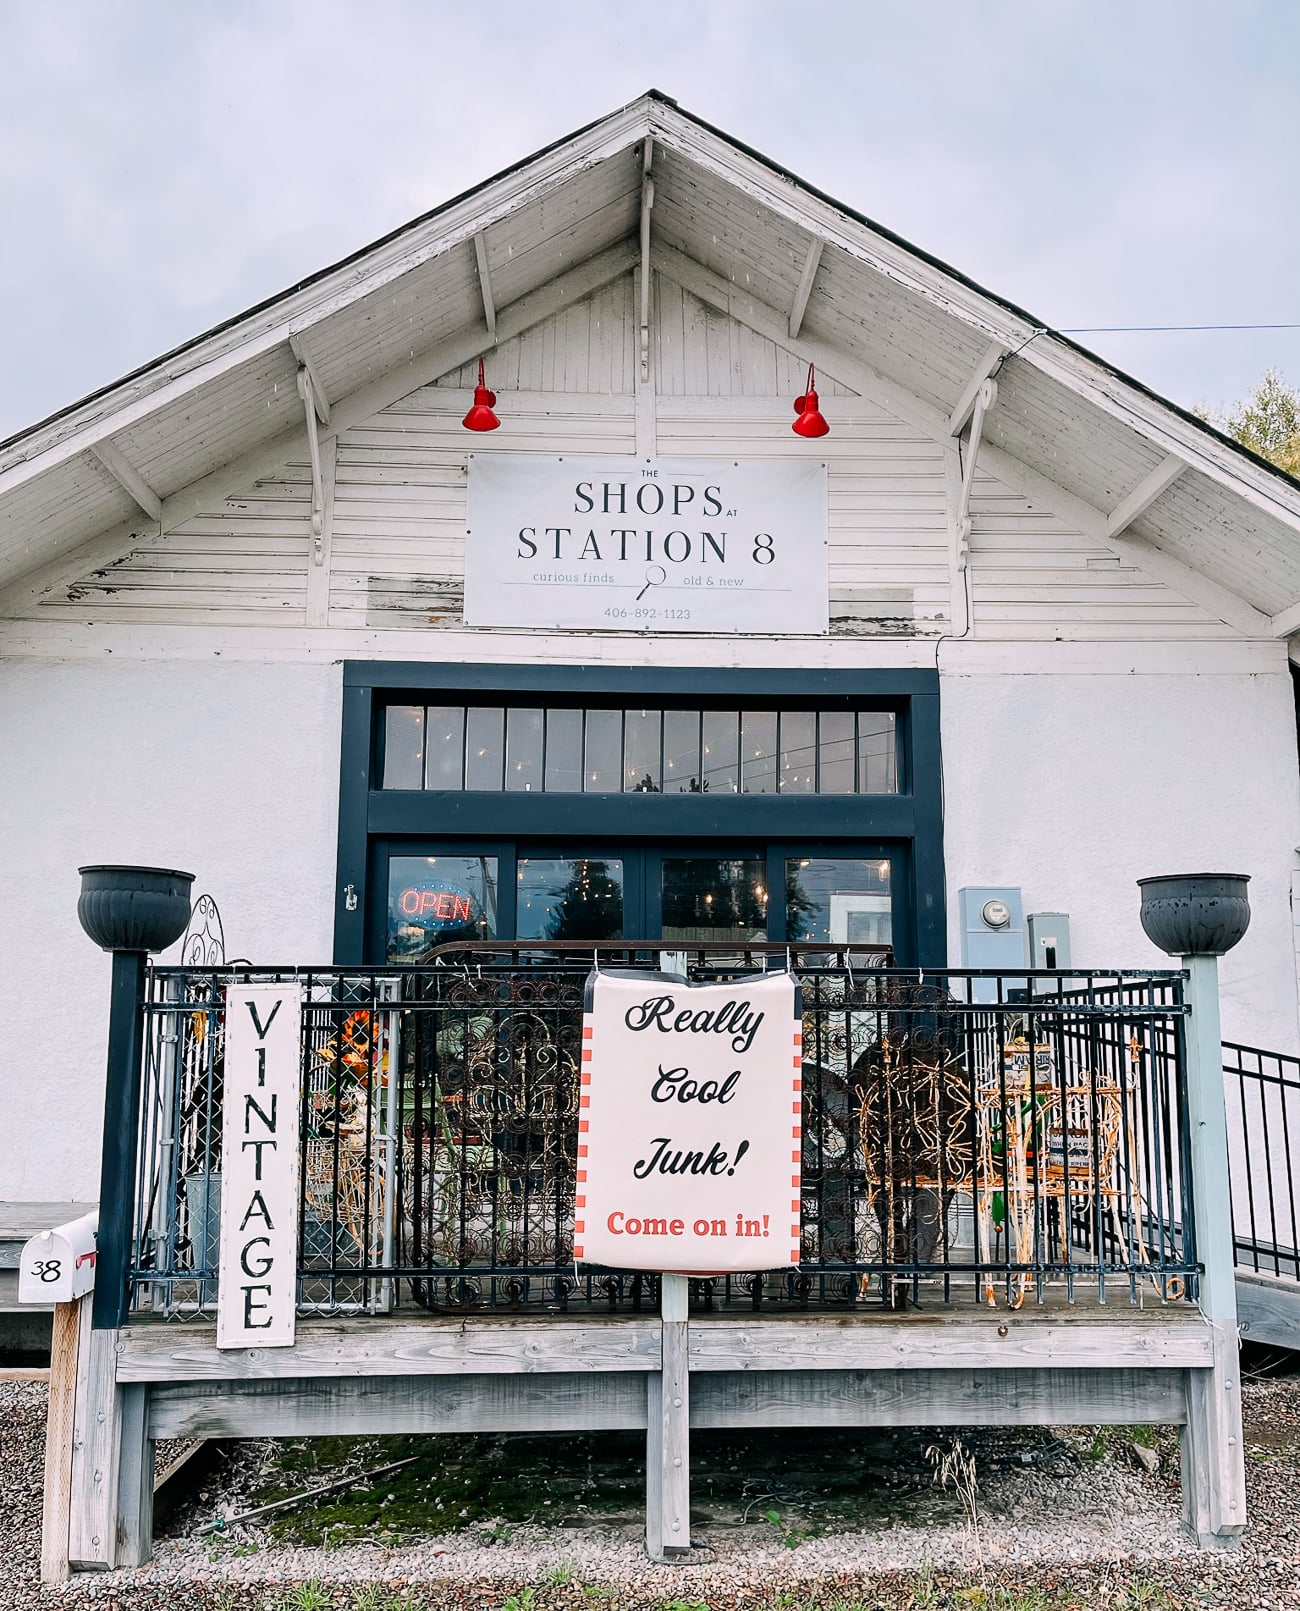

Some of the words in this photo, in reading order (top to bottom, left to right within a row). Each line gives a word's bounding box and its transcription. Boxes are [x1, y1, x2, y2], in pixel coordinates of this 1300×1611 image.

[641, 469, 659, 478] THE
[574, 481, 723, 517] SHOPS
[725, 509, 738, 517] AT
[517, 527, 728, 563] STATION
[752, 533, 776, 565] 8
[533, 571, 579, 583] curious
[583, 572, 614, 583] finds
[683, 575, 702, 586] old
[706, 577, 714, 586] &
[719, 578, 744, 586] new
[604, 607, 691, 620] 406-892-1123
[400, 889, 471, 921] OPEN
[624, 995, 765, 1053] Really
[650, 1064, 742, 1104] Cool
[239, 1000, 282, 1329] VINTAGE
[633, 1138, 750, 1179] Junk!
[606, 1211, 685, 1236] Come
[693, 1219, 727, 1237] on
[736, 1214, 770, 1237] in!
[31, 1260, 61, 1283] 38
